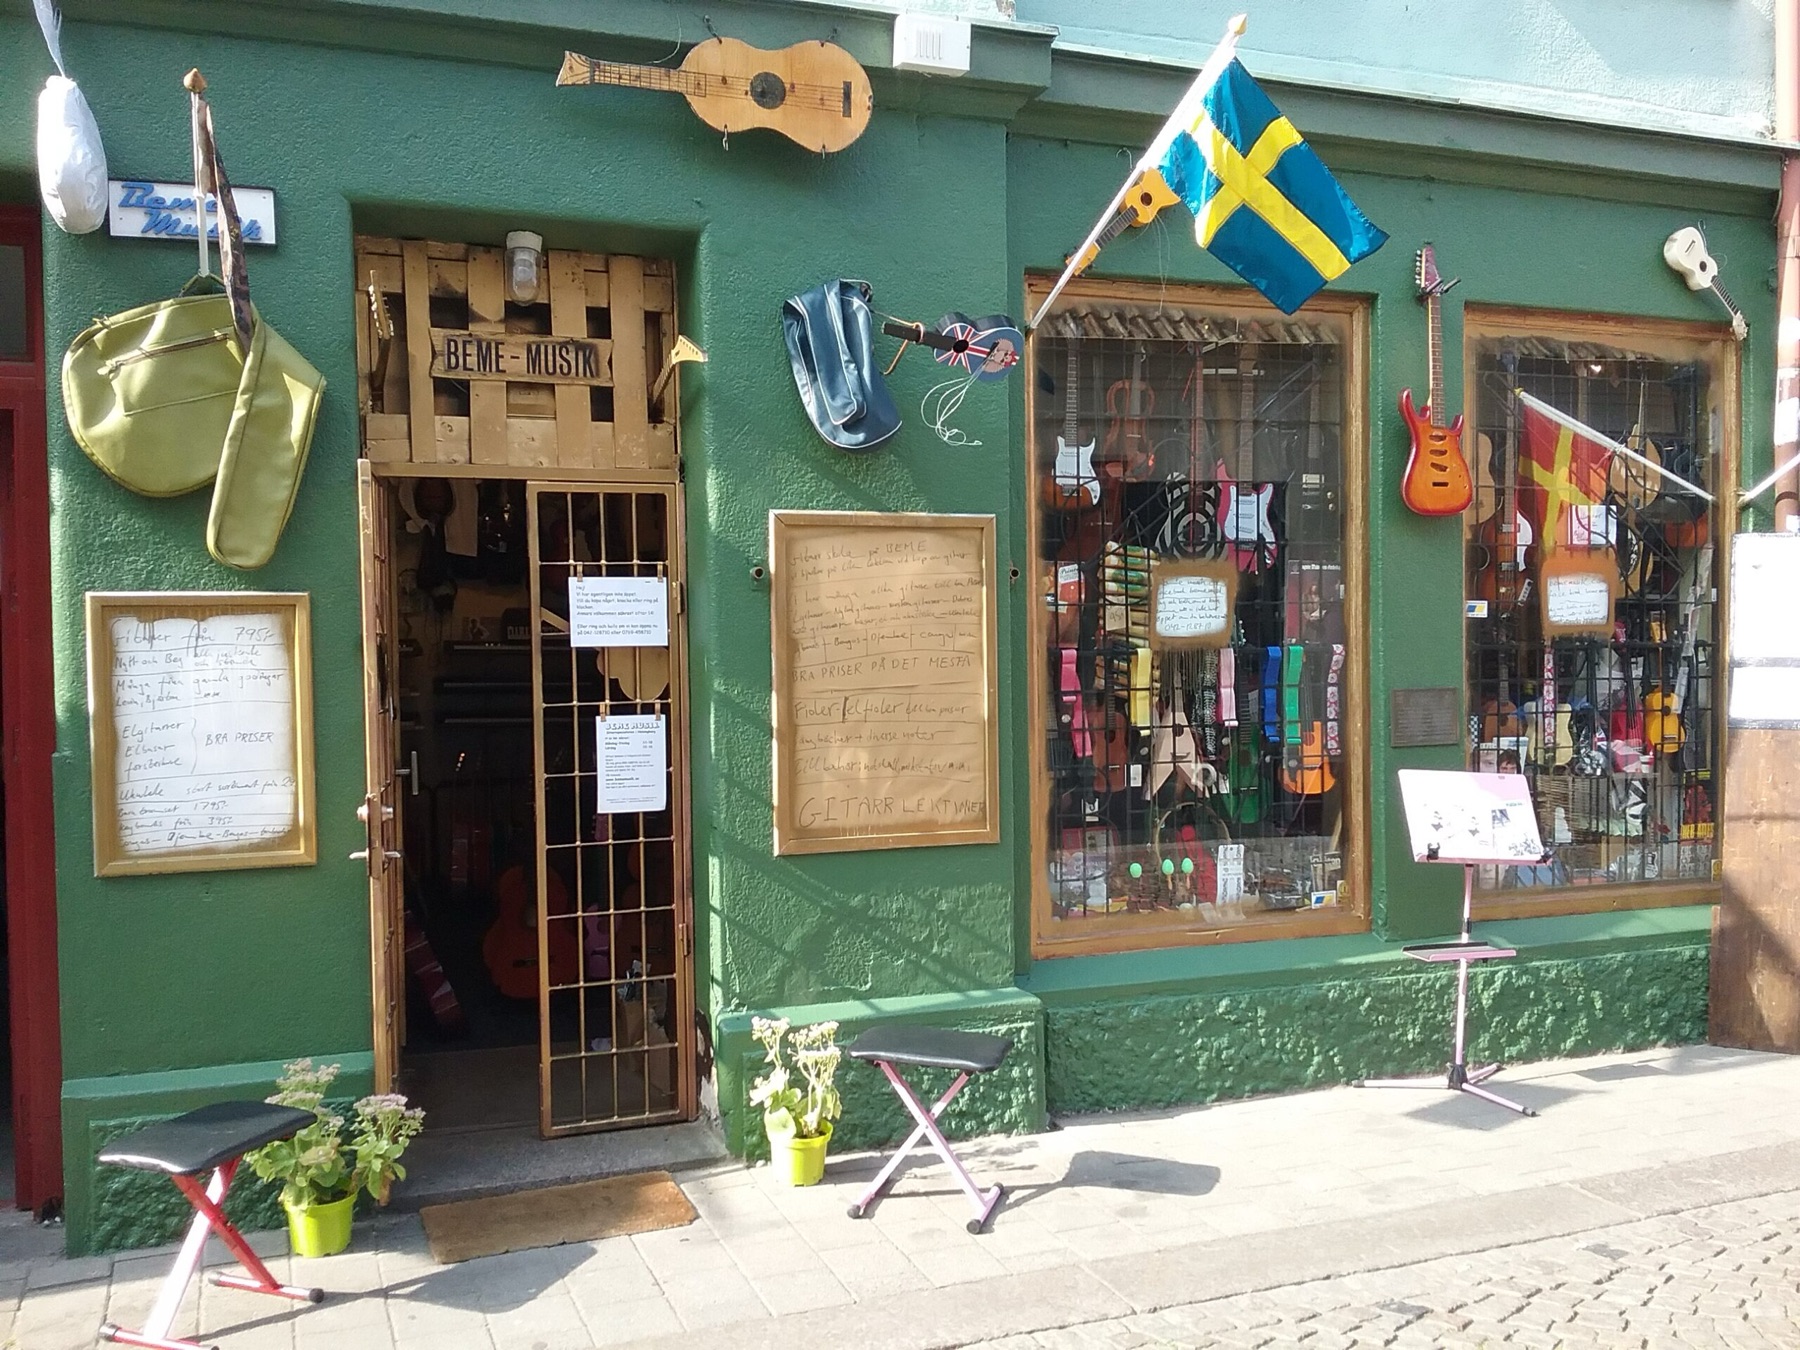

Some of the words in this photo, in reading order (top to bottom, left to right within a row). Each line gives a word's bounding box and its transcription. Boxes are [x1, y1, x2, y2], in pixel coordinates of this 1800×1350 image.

[886, 540, 927, 553] BEME
[165, 653, 184, 669] Beg
[792, 669, 815, 682] BRA
[821, 662, 863, 678] PRISER
[871, 657, 886, 671] PÅ
[892, 657, 919, 670] DET
[929, 655, 971, 669] MESTA
[122, 722, 185, 743] Elgitarrer
[205, 732, 228, 747] BRA
[235, 731, 275, 744] PRISER
[866, 728, 900, 742] diverse
[799, 796, 895, 828] GITARR
